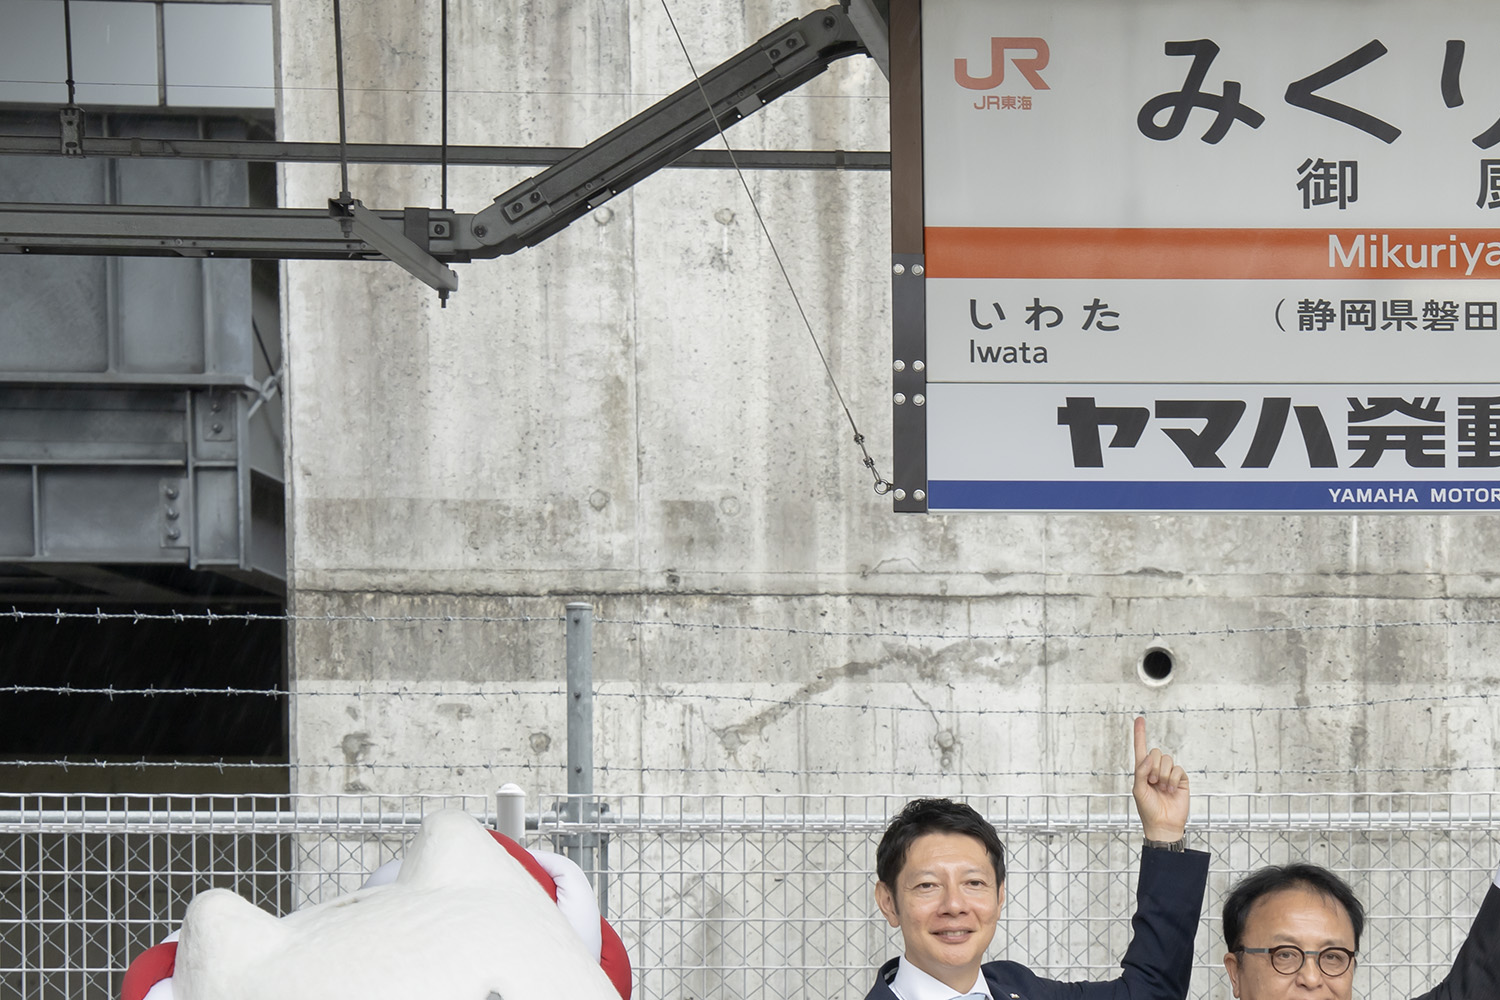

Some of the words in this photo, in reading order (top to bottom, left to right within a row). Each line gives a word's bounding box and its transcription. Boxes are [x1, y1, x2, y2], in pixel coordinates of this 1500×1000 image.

[953, 36, 1051, 91] JR
[973, 95, 1033, 111] JR東海
[969, 297, 1120, 332] いわた
[969, 339, 1048, 364] Iwata
[1328, 488, 1419, 503] YAMAHA
